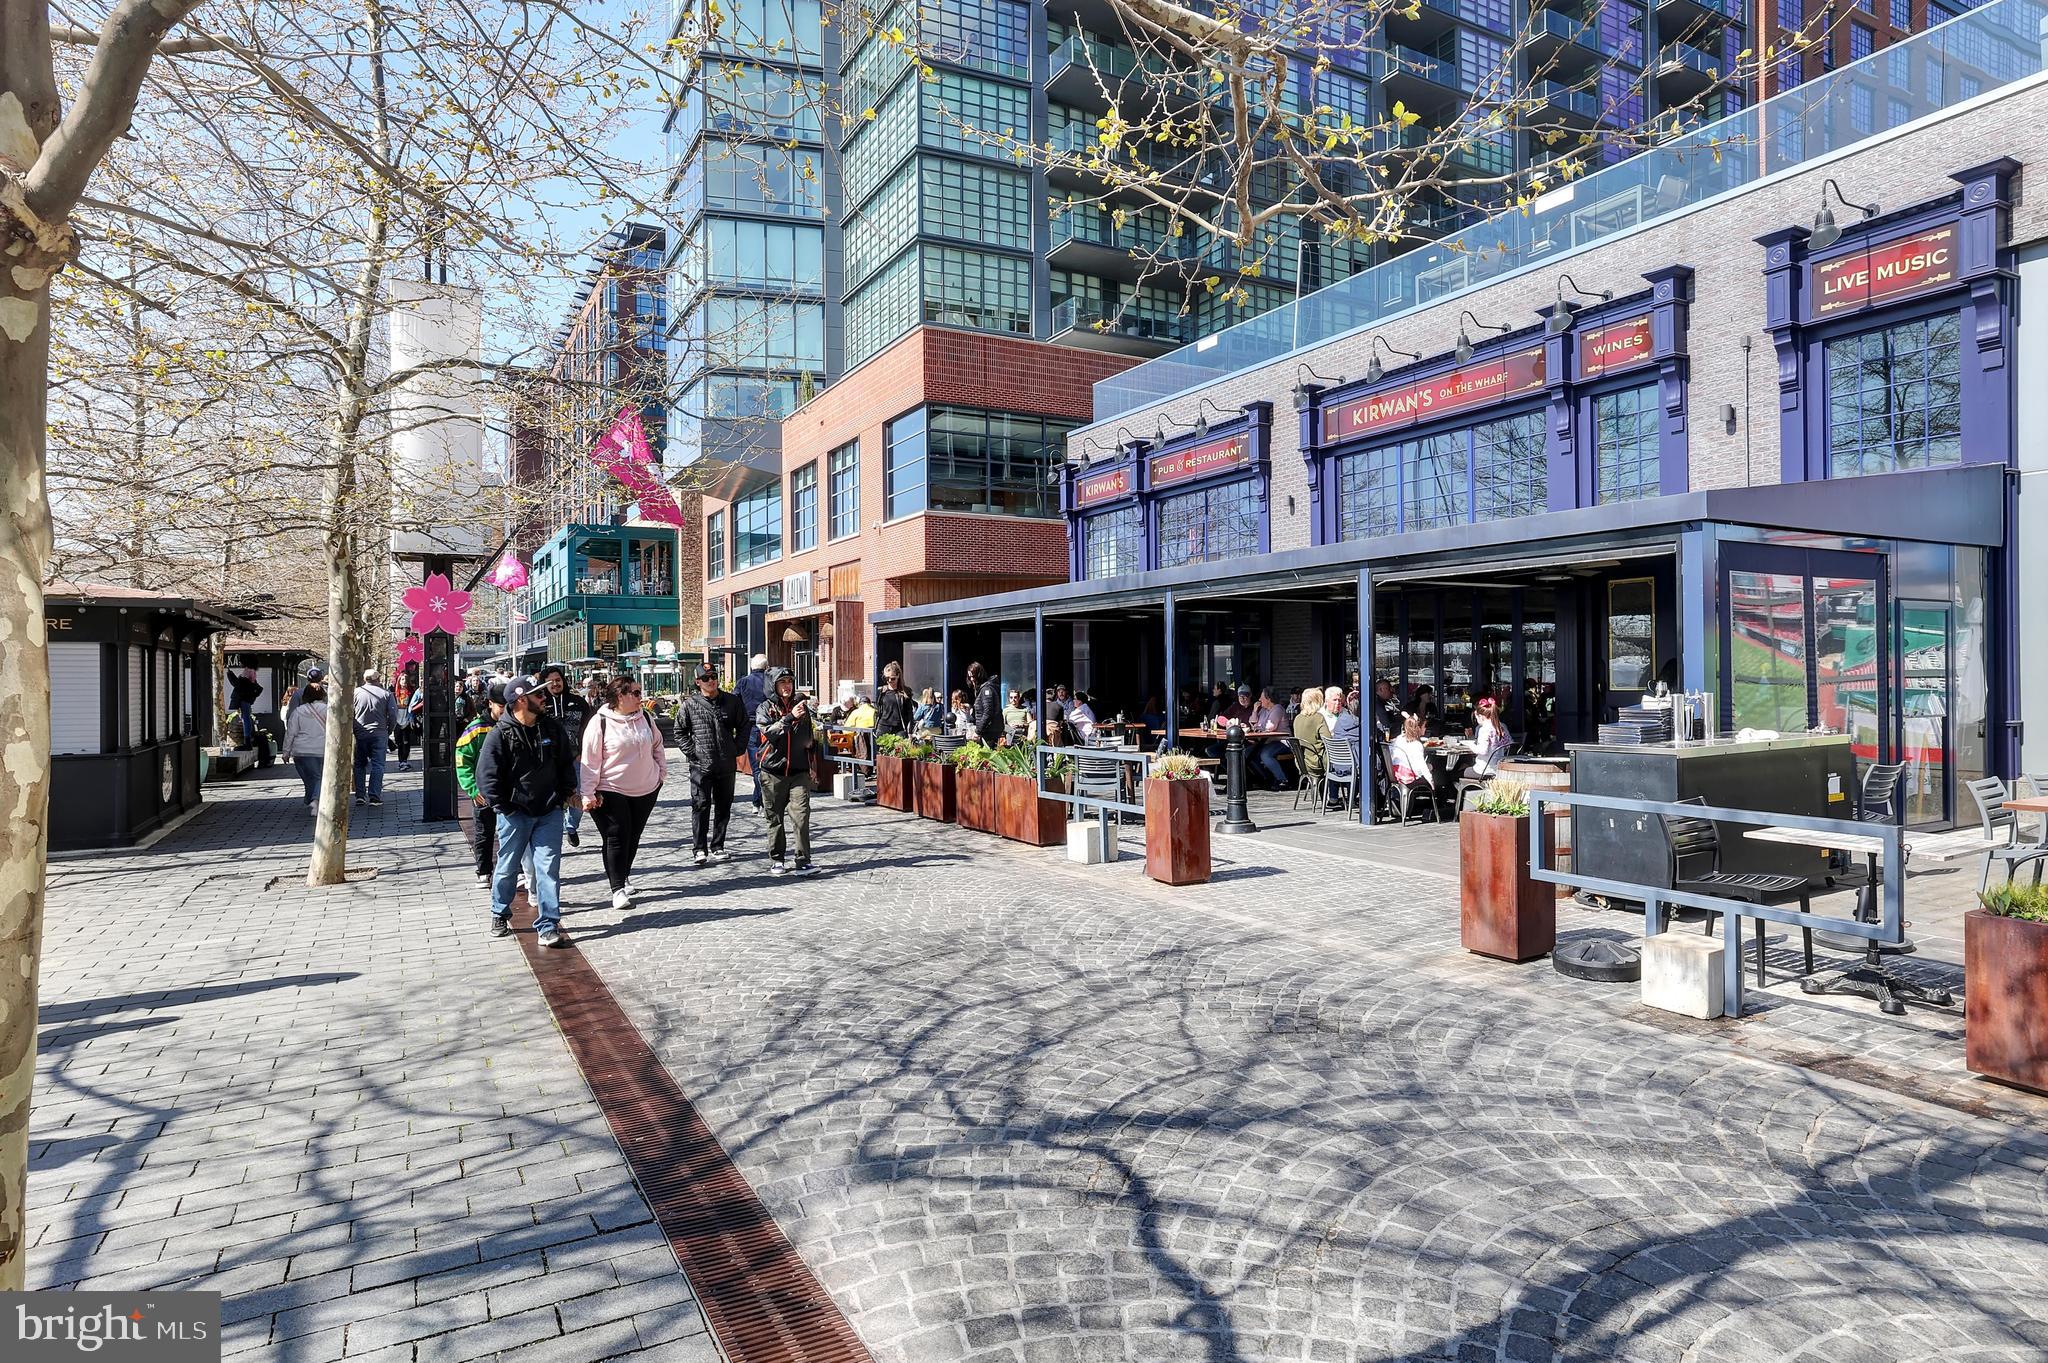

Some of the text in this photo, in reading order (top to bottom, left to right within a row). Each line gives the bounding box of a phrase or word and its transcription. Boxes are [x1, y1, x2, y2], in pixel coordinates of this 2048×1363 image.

[1824, 249, 1948, 295] LIVE MUSIC
[1592, 335, 1643, 356] WINES
[1352, 371, 1508, 426] KIRWAN'S ON THE WHARF
[1158, 465, 1175, 476] PUB
[1185, 445, 1243, 468] RESTAURANT
[1085, 477, 1124, 497] KIRWAN'S
